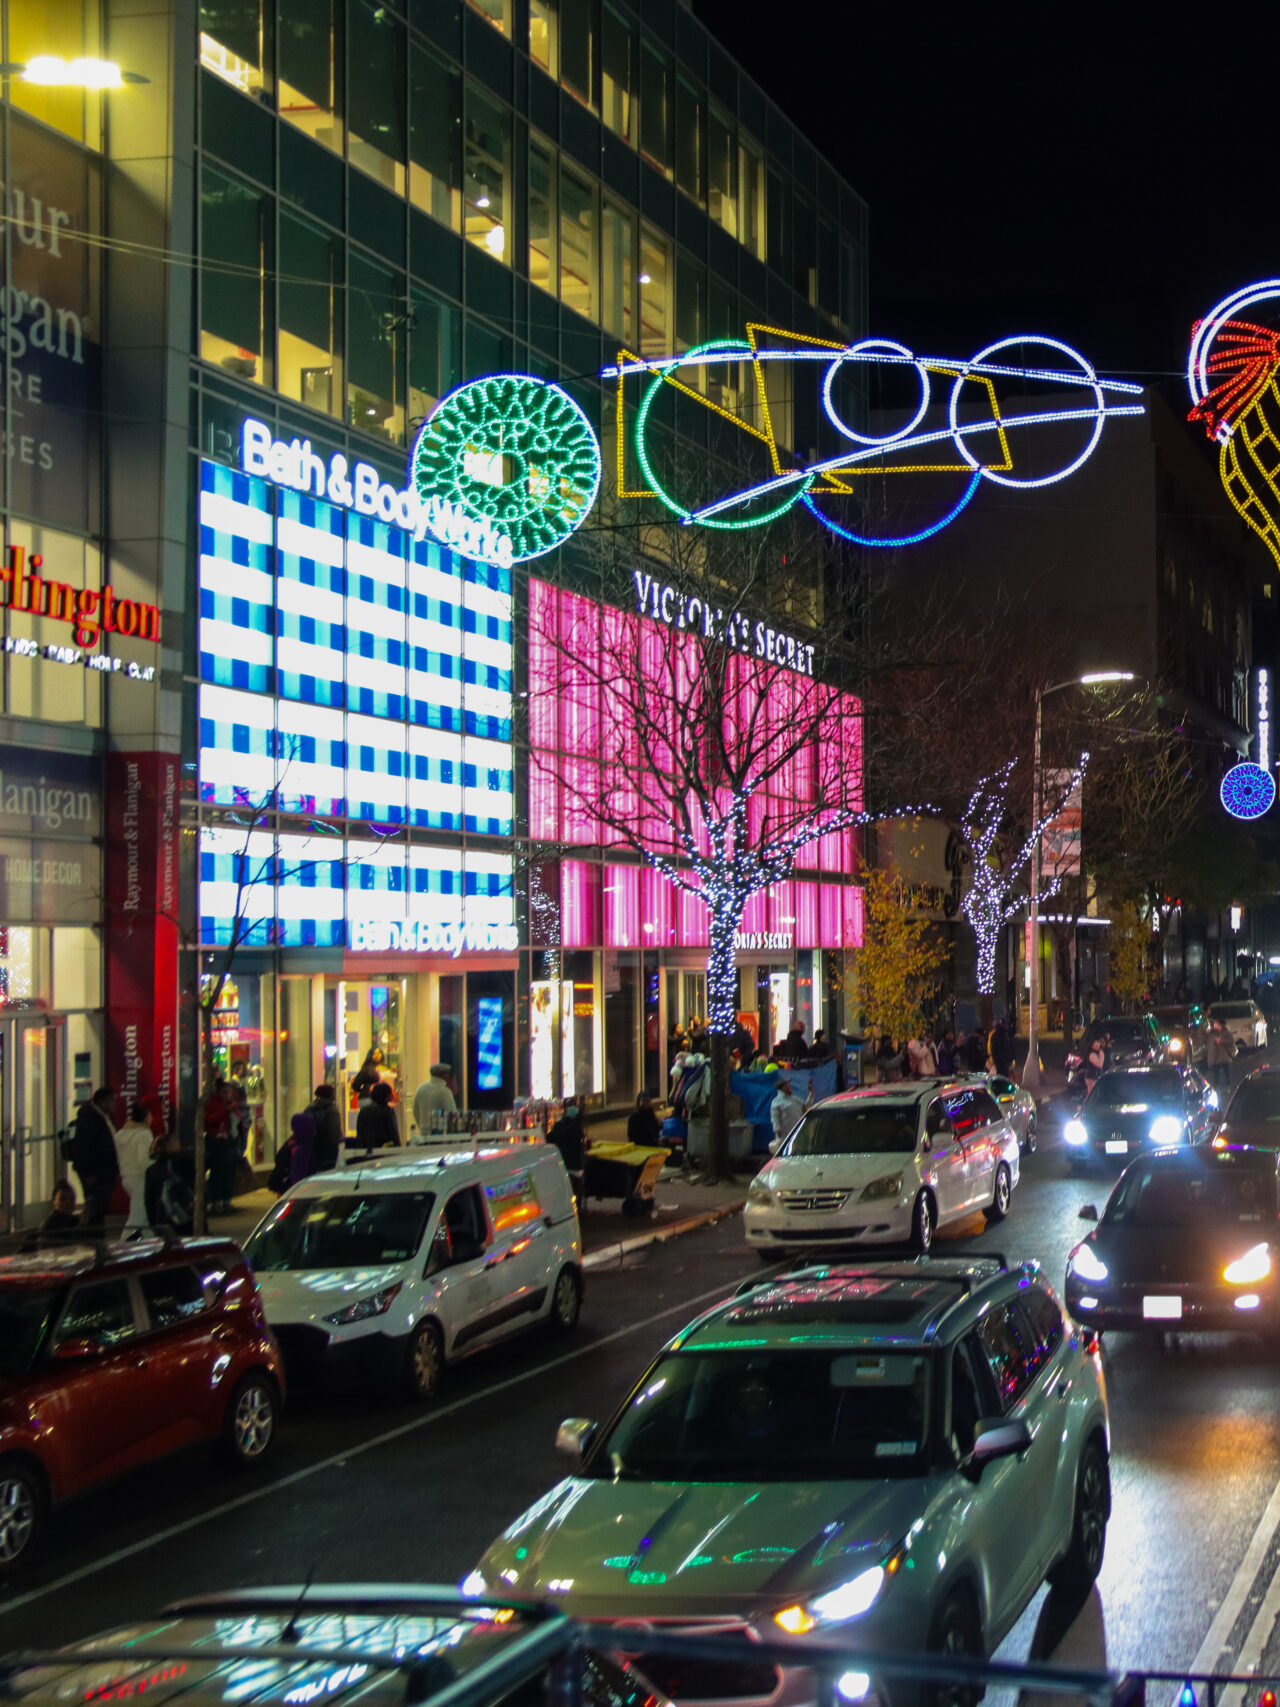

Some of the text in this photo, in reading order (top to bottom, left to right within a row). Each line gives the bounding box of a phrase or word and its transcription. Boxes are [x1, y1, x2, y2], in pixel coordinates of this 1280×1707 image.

[244, 417, 325, 496] Bath
[328, 453, 354, 507] &
[355, 462, 433, 542] Body
[755, 621, 815, 676] SECRET
[123, 763, 142, 911] Raymour & Flanigan
[5, 858, 82, 886] HOME DECOR
[162, 844, 176, 911] Raymour
[763, 930, 793, 950] SECRET
